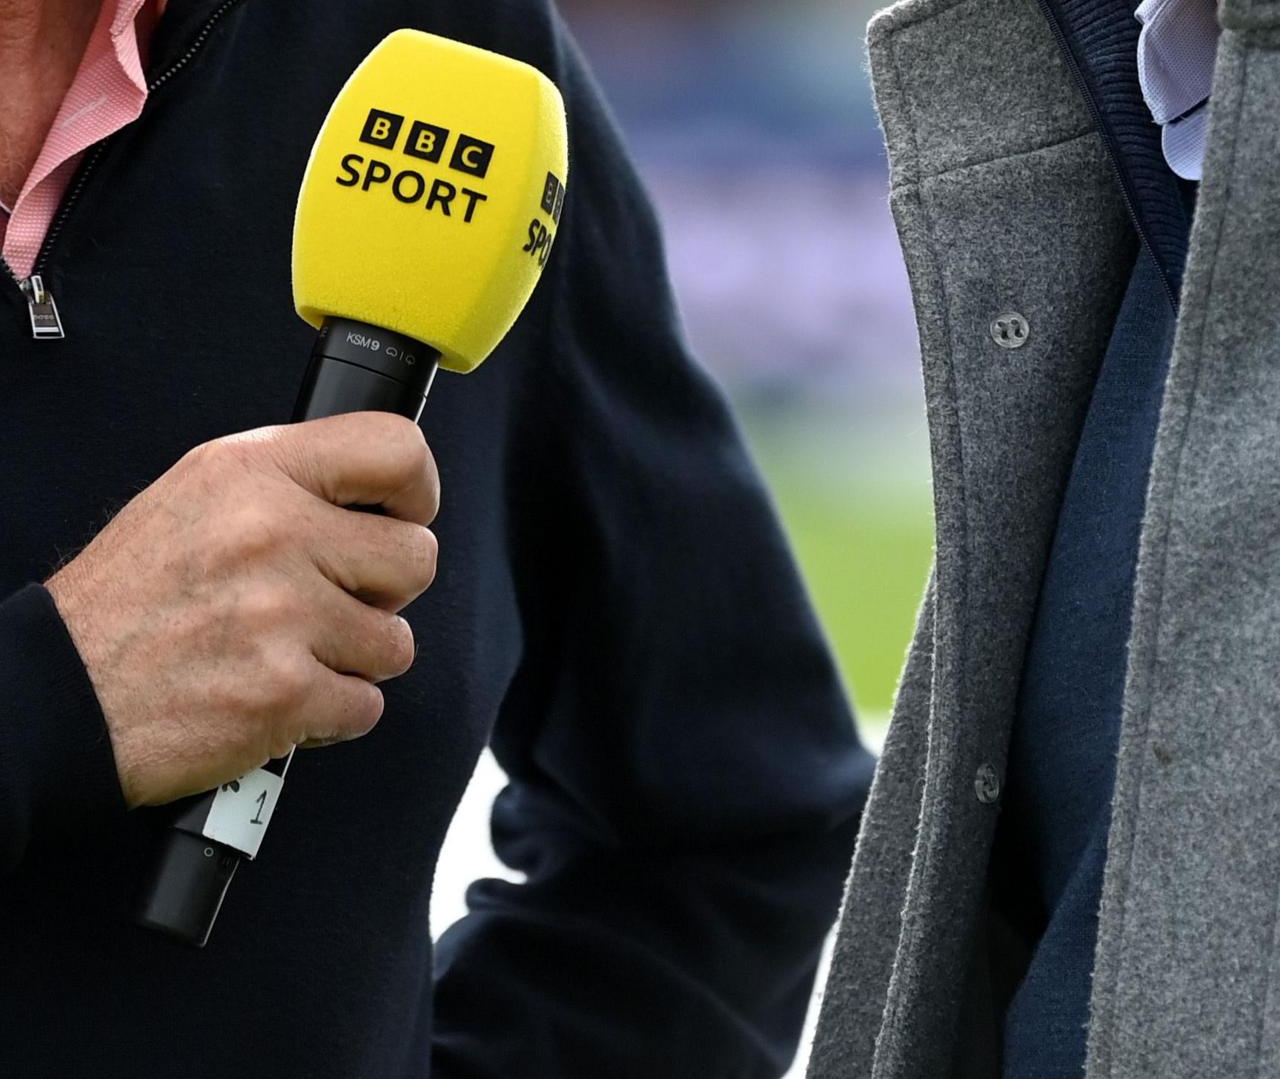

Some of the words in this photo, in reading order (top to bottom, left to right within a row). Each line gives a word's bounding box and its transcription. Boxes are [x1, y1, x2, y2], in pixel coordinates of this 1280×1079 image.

[362, 110, 493, 177] BBC
[335, 153, 488, 224] SPORT
[522, 218, 553, 268] SPO
[346, 331, 381, 351] KSM9
[250, 789, 267, 825] 1
